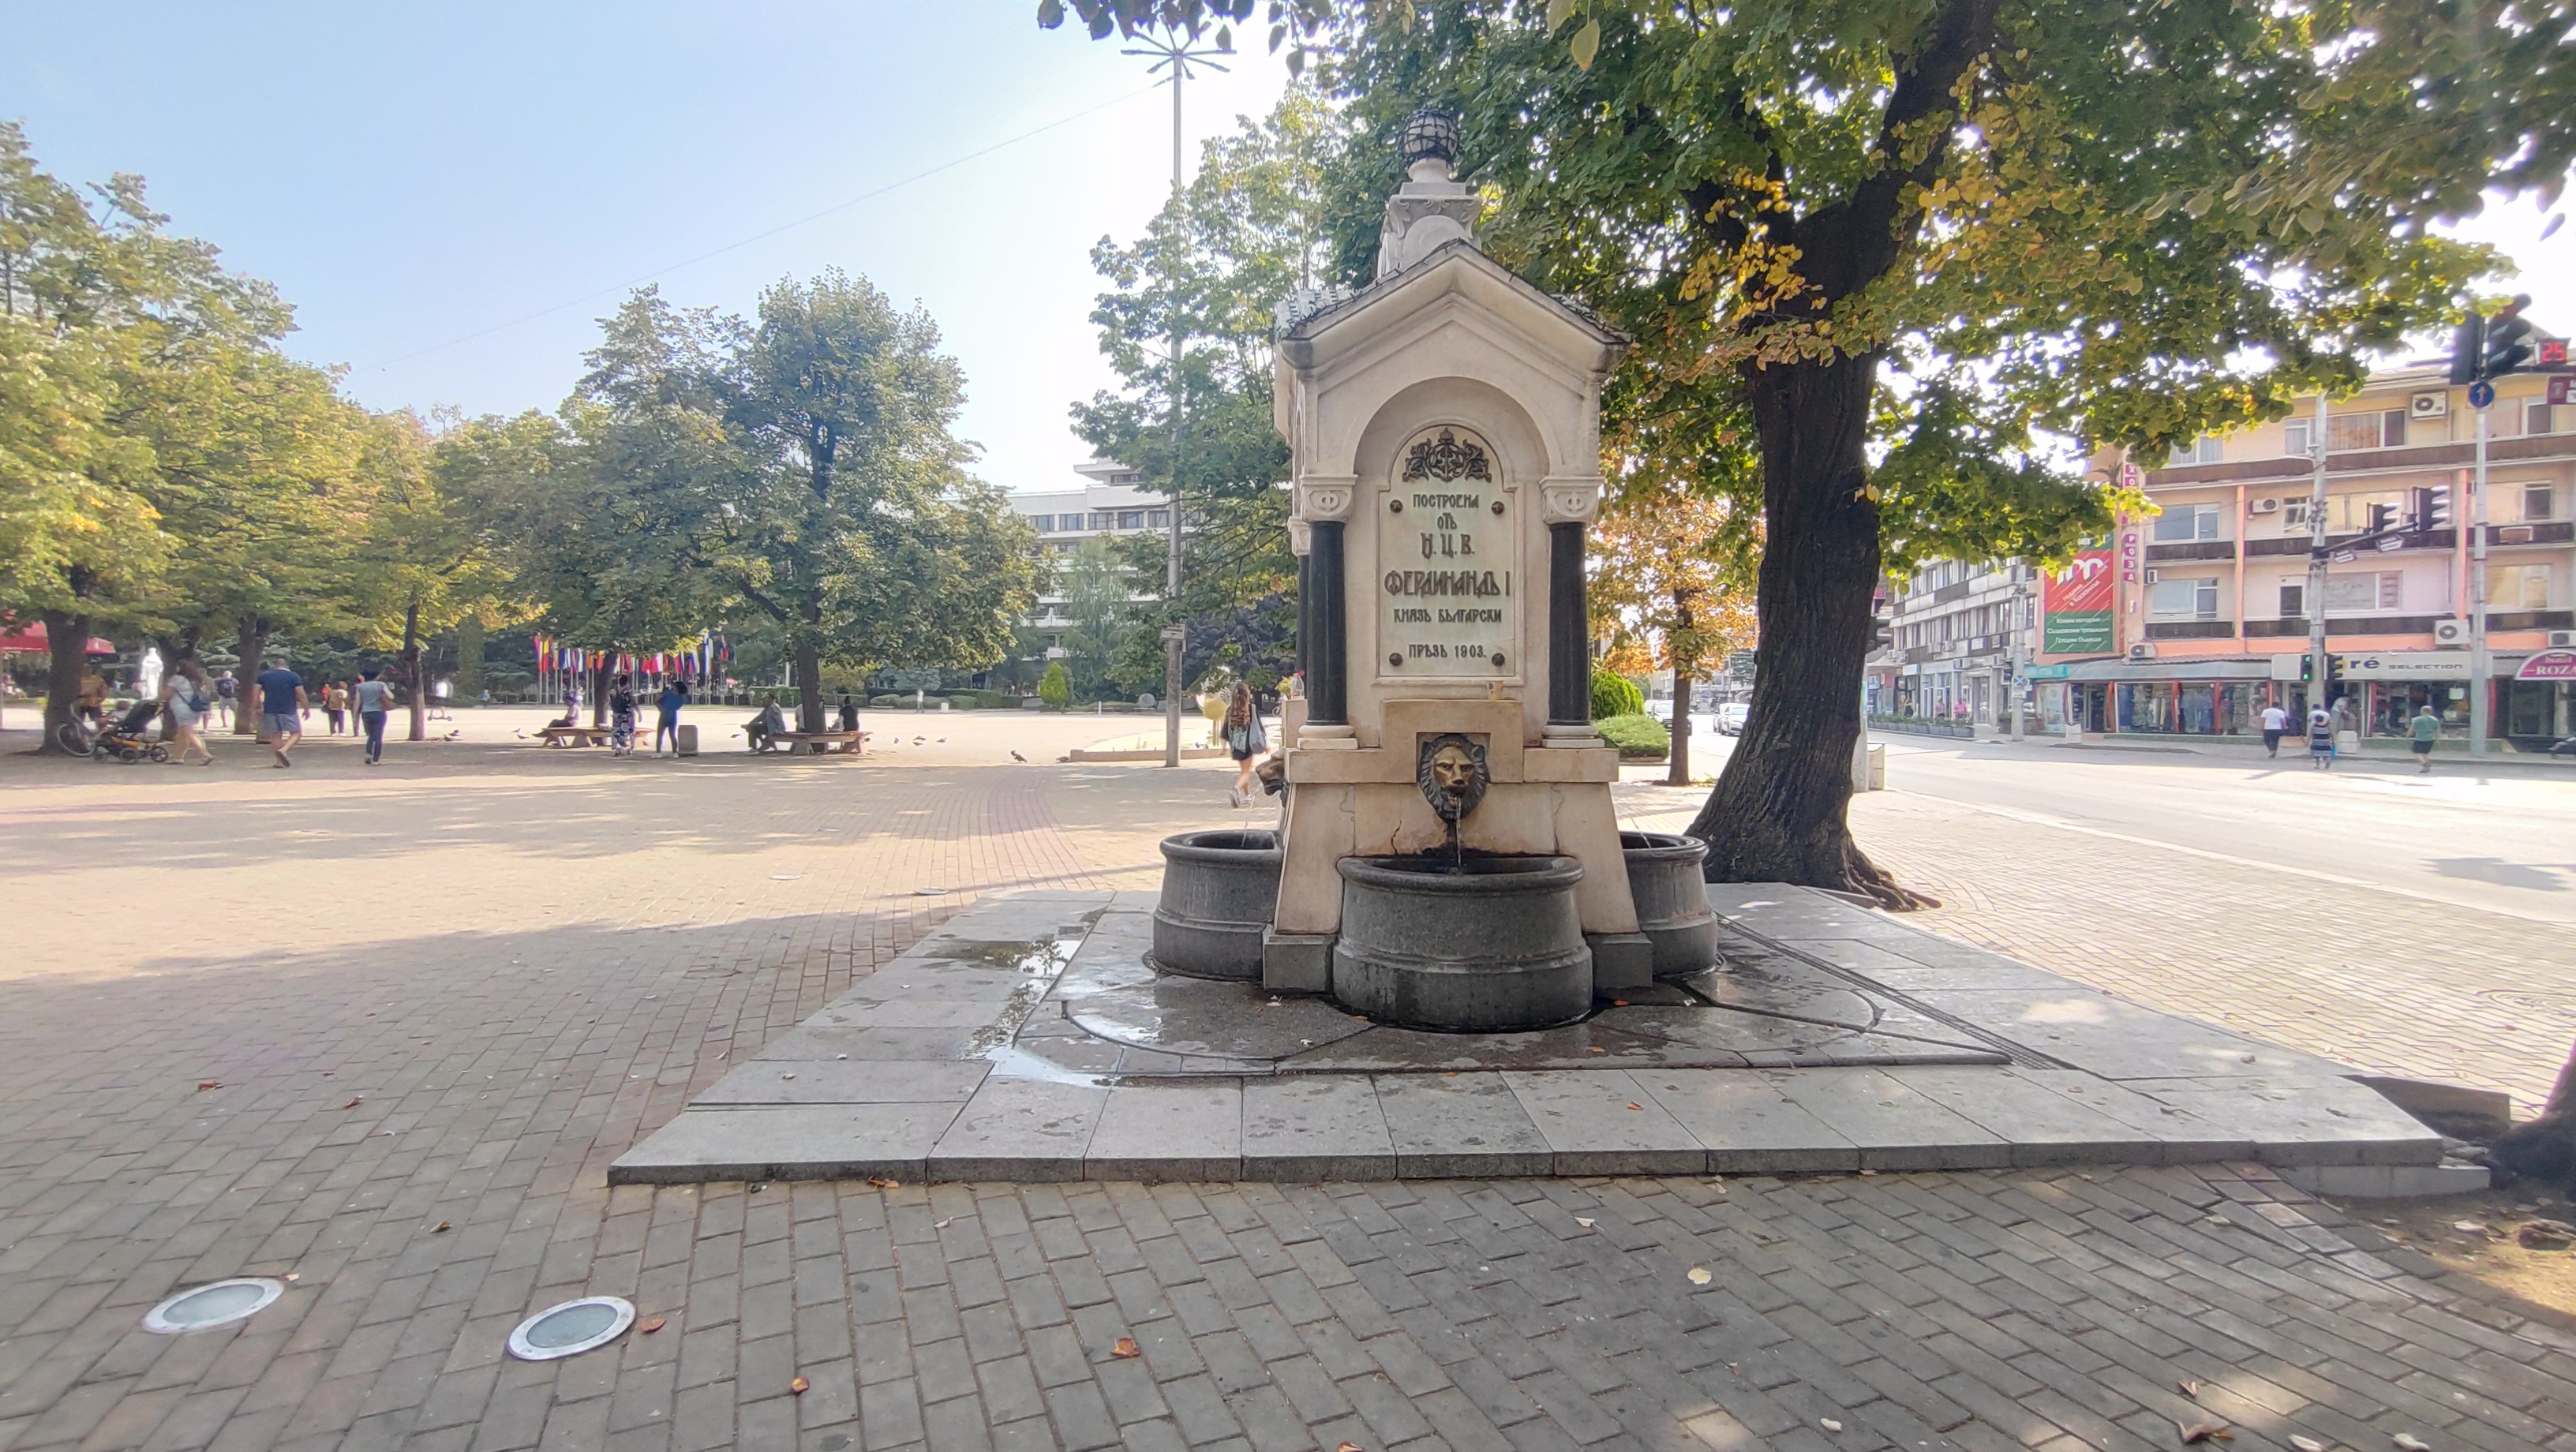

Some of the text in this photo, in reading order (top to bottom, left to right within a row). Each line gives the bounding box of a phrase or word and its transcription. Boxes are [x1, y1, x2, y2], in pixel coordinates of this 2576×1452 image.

[2541, 341, 2566, 361] 25
[1413, 493, 1480, 508] ПОСТРОЕНА
[1437, 512, 1458, 530] ОТЪ
[1394, 608, 1503, 623] КНЯЗЪ БЪЛГАРСКИ
[1454, 645, 1487, 659] 1903.
